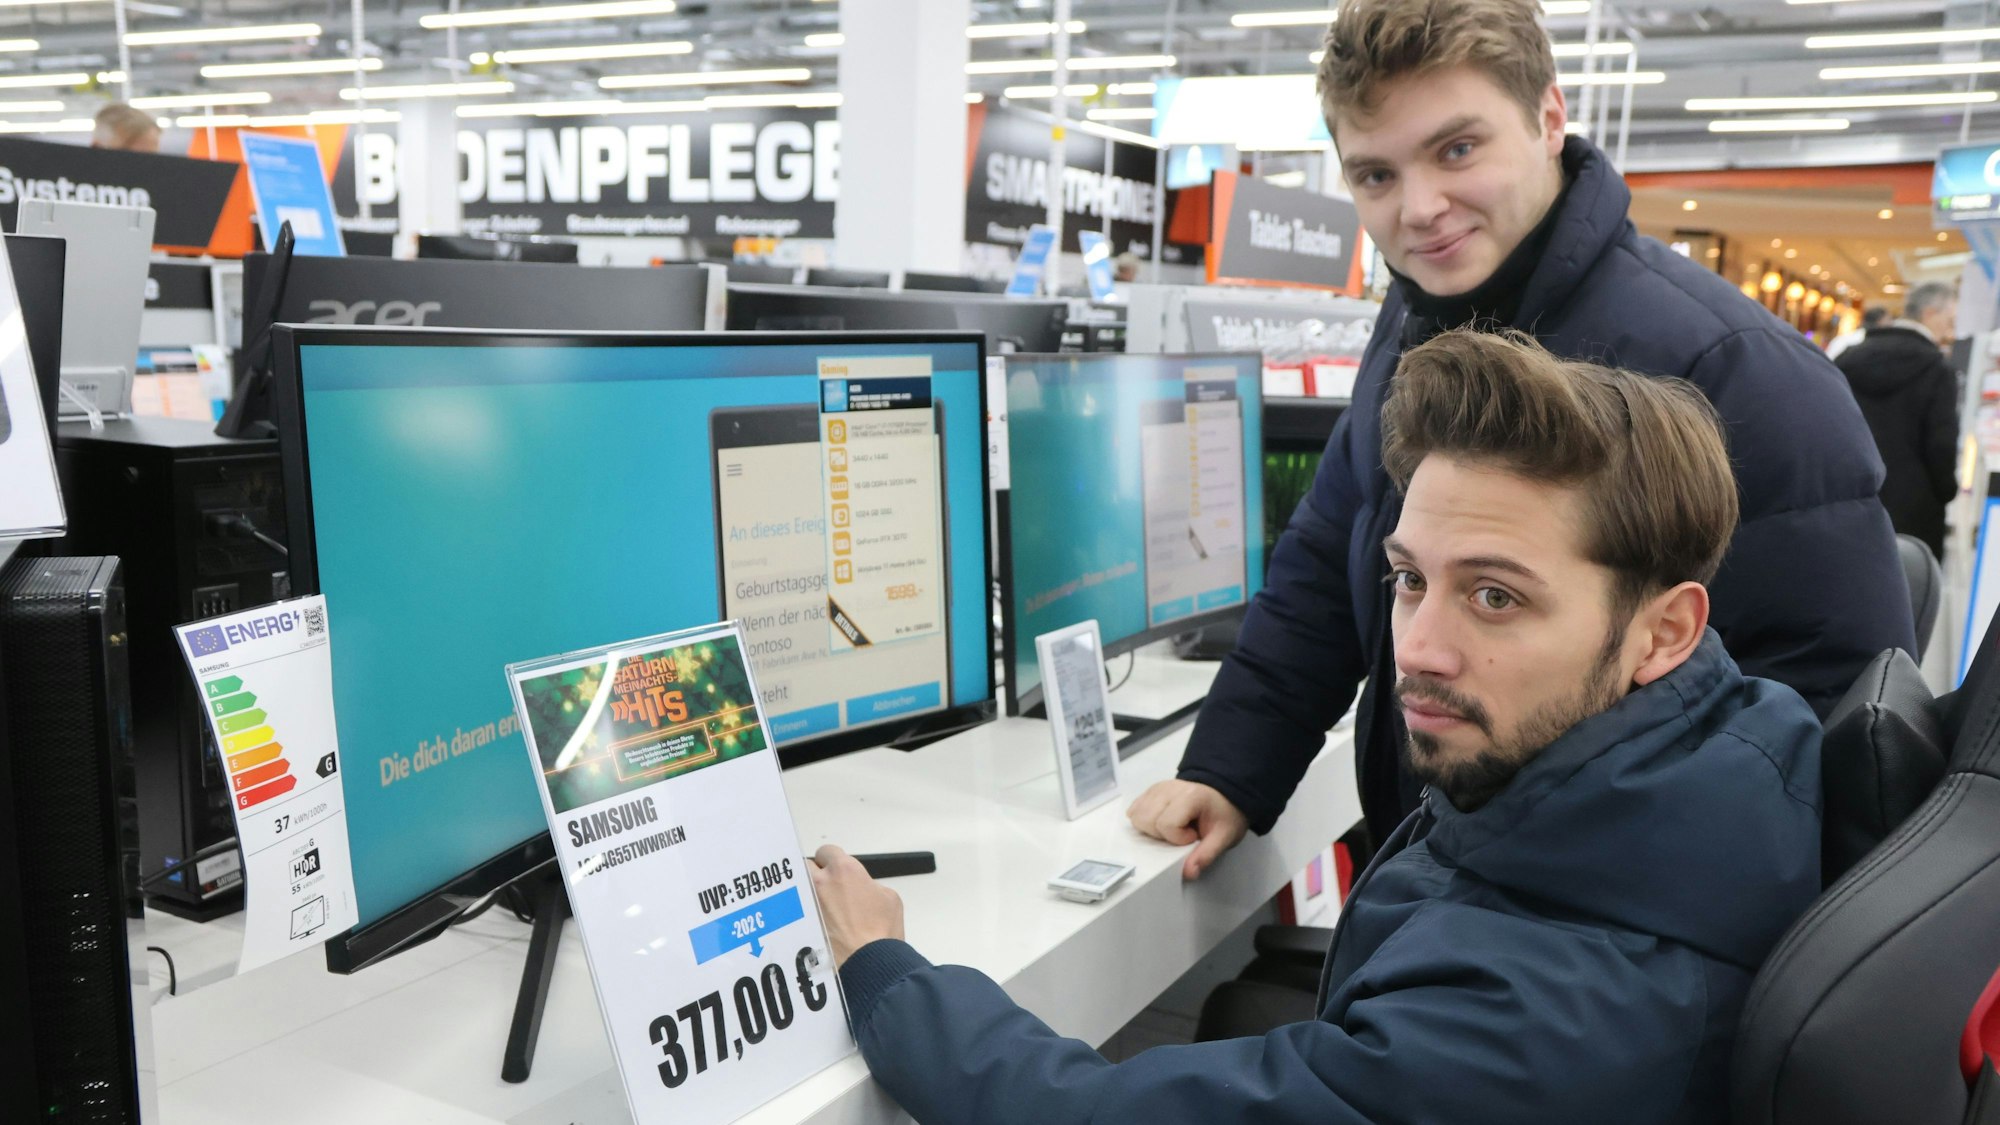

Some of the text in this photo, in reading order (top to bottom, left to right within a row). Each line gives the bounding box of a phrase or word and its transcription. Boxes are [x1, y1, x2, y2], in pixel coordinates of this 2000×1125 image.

[354, 120, 842, 204] BDENPFLEGE
[304, 299, 441, 326] acer
[821, 364, 848, 377] Gaming
[730, 525, 747, 541] An
[751, 522, 790, 539] dieses
[736, 573, 828, 600] Geburtstagsge
[225, 612, 294, 645] ENERG
[778, 608, 800, 626] der
[834, 612, 859, 641] DETAILS
[199, 661, 230, 675] SAMSUNG
[614, 656, 677, 684] SATURN
[210, 684, 218, 694] A
[216, 703, 224, 713] B
[222, 721, 229, 731] C
[232, 759, 238, 769] E
[326, 756, 333, 772] G
[380, 752, 410, 787] Die
[413, 735, 448, 773] dich
[451, 718, 497, 757] daran
[236, 777, 242, 788] F
[240, 796, 248, 806] G
[275, 803, 328, 834] 37 kWh/1000h
[567, 796, 659, 848] SAMSUNG
[294, 855, 317, 878] HDR
[292, 883, 301, 895] 55
[698, 857, 794, 915] UVP: 579,00 €
[731, 911, 765, 940] -202 €
[649, 946, 828, 1089] 377,00 €
